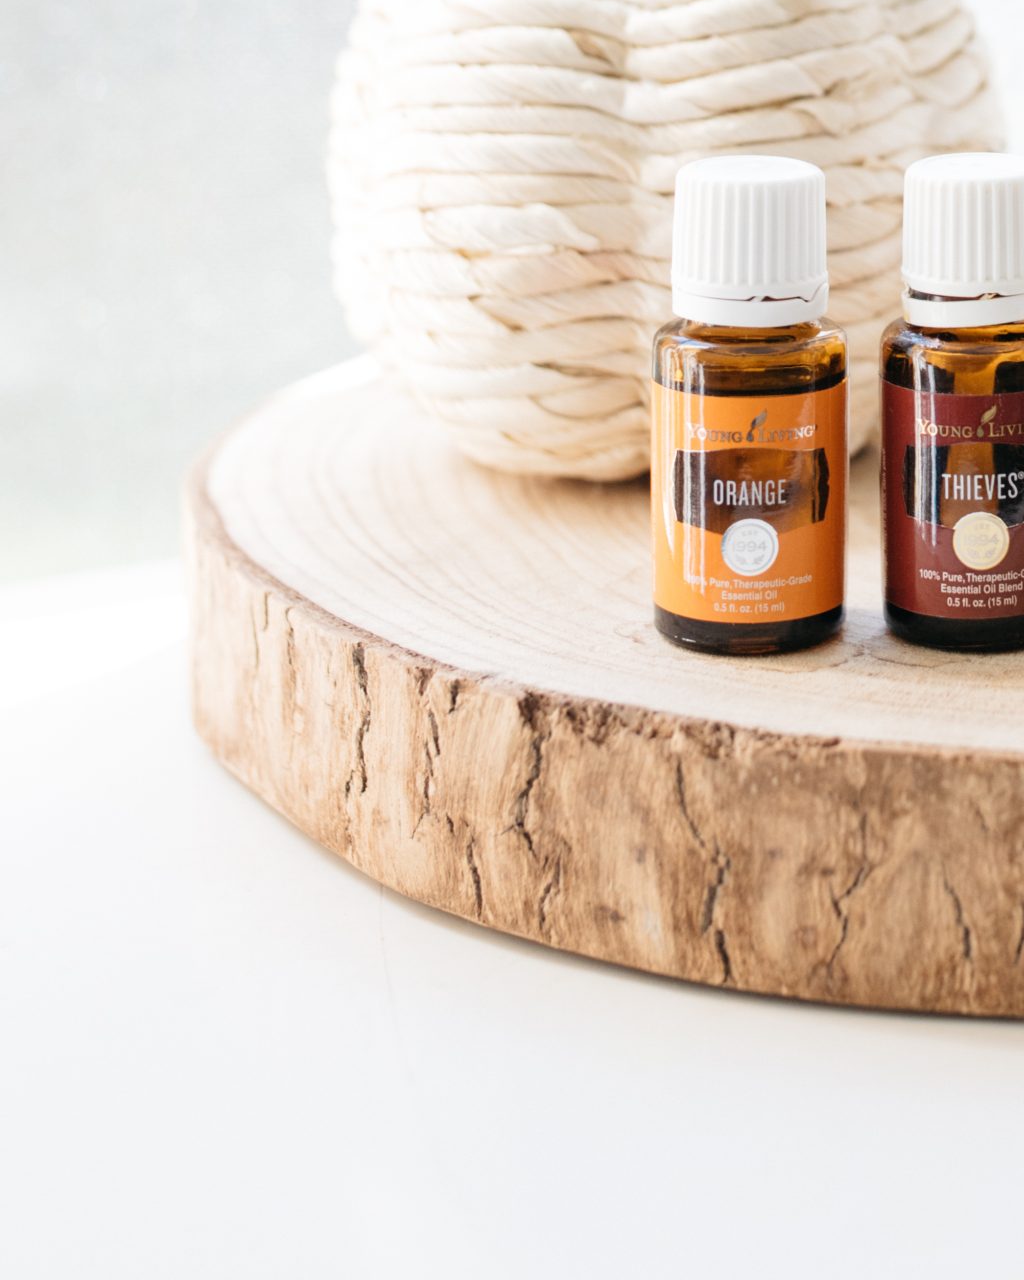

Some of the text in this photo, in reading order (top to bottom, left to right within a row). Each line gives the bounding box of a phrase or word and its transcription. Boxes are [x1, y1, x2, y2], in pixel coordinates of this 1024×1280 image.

[686, 422, 743, 443] YOUNG
[917, 418, 973, 438] YOUNG
[713, 479, 787, 505] ORANGE
[709, 577, 732, 589] Pure,
[733, 574, 813, 589] Therapeutic-Grade
[920, 569, 940, 581] 100%
[942, 571, 966, 584] Pure,
[940, 581, 1023, 594] Essential Oil Blend
[721, 590, 777, 601] Essential Oil
[947, 595, 1018, 609] 0.5 fl. oz. (15 ml)
[713, 601, 785, 614] 0.5 fl. oz. (15 ml)
